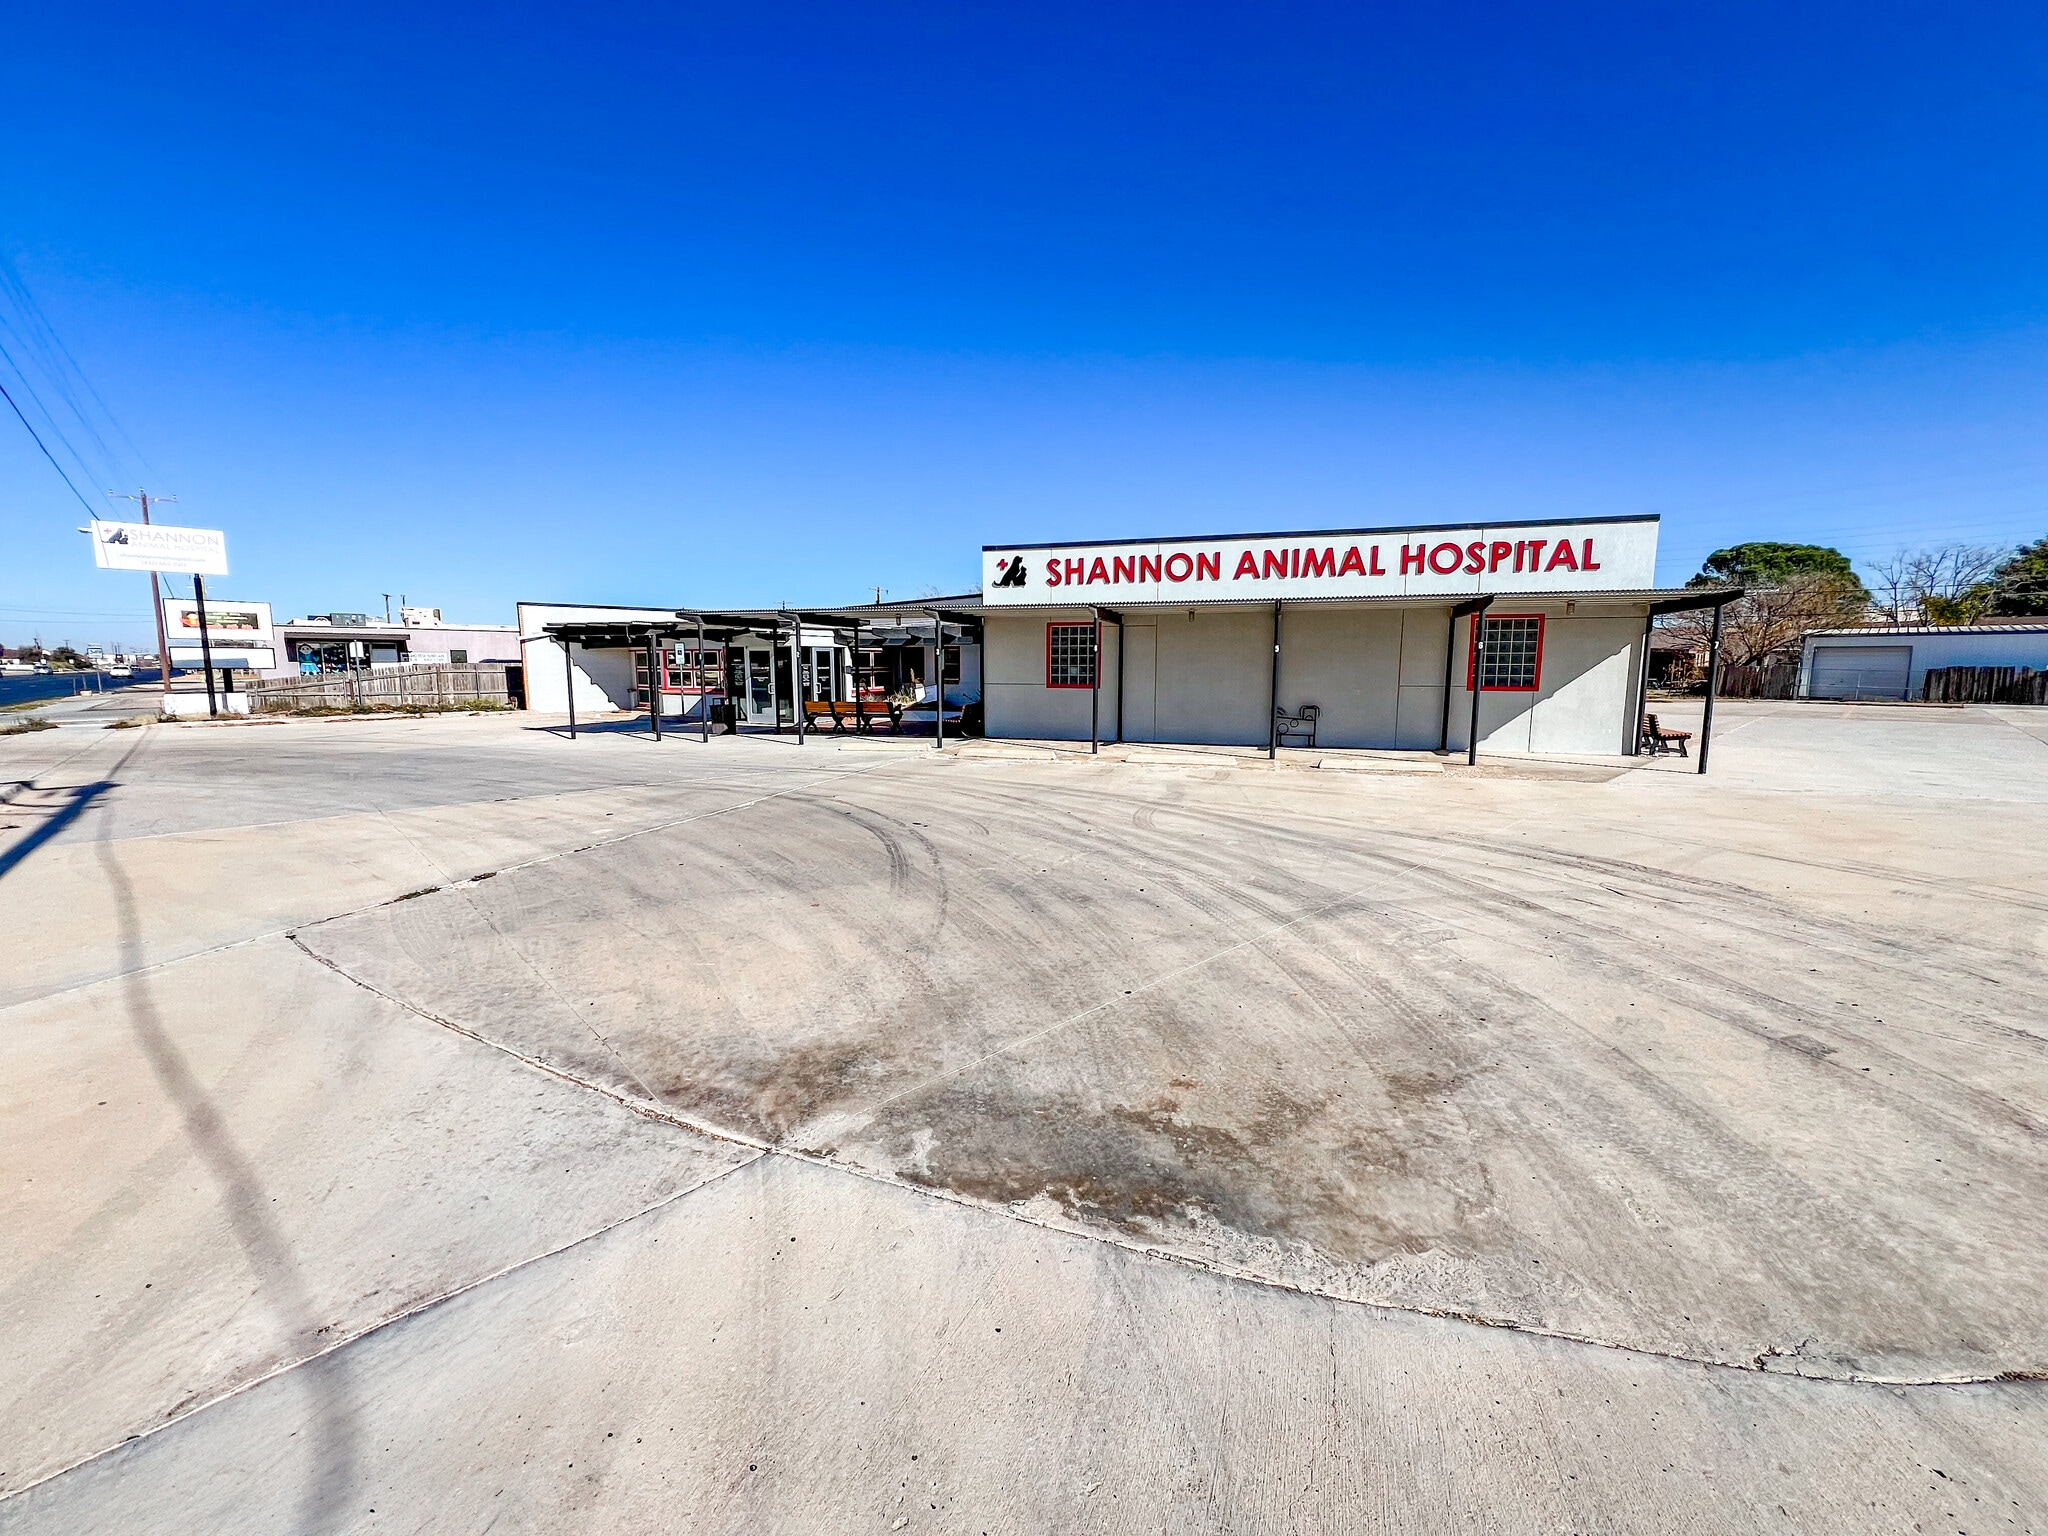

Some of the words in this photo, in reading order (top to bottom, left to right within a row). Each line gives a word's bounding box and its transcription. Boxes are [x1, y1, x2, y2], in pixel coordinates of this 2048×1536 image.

[129, 528, 220, 546] SHANNON
[131, 541, 171, 551] ANIMAL
[174, 543, 220, 554] HOSPITAL
[1045, 551, 1221, 587] SHANNON
[1233, 545, 1386, 580] ANIMAL
[1399, 538, 1601, 576] HOSPITAL
[1478, 641, 1484, 649] 6
[1714, 641, 1720, 649] 7
